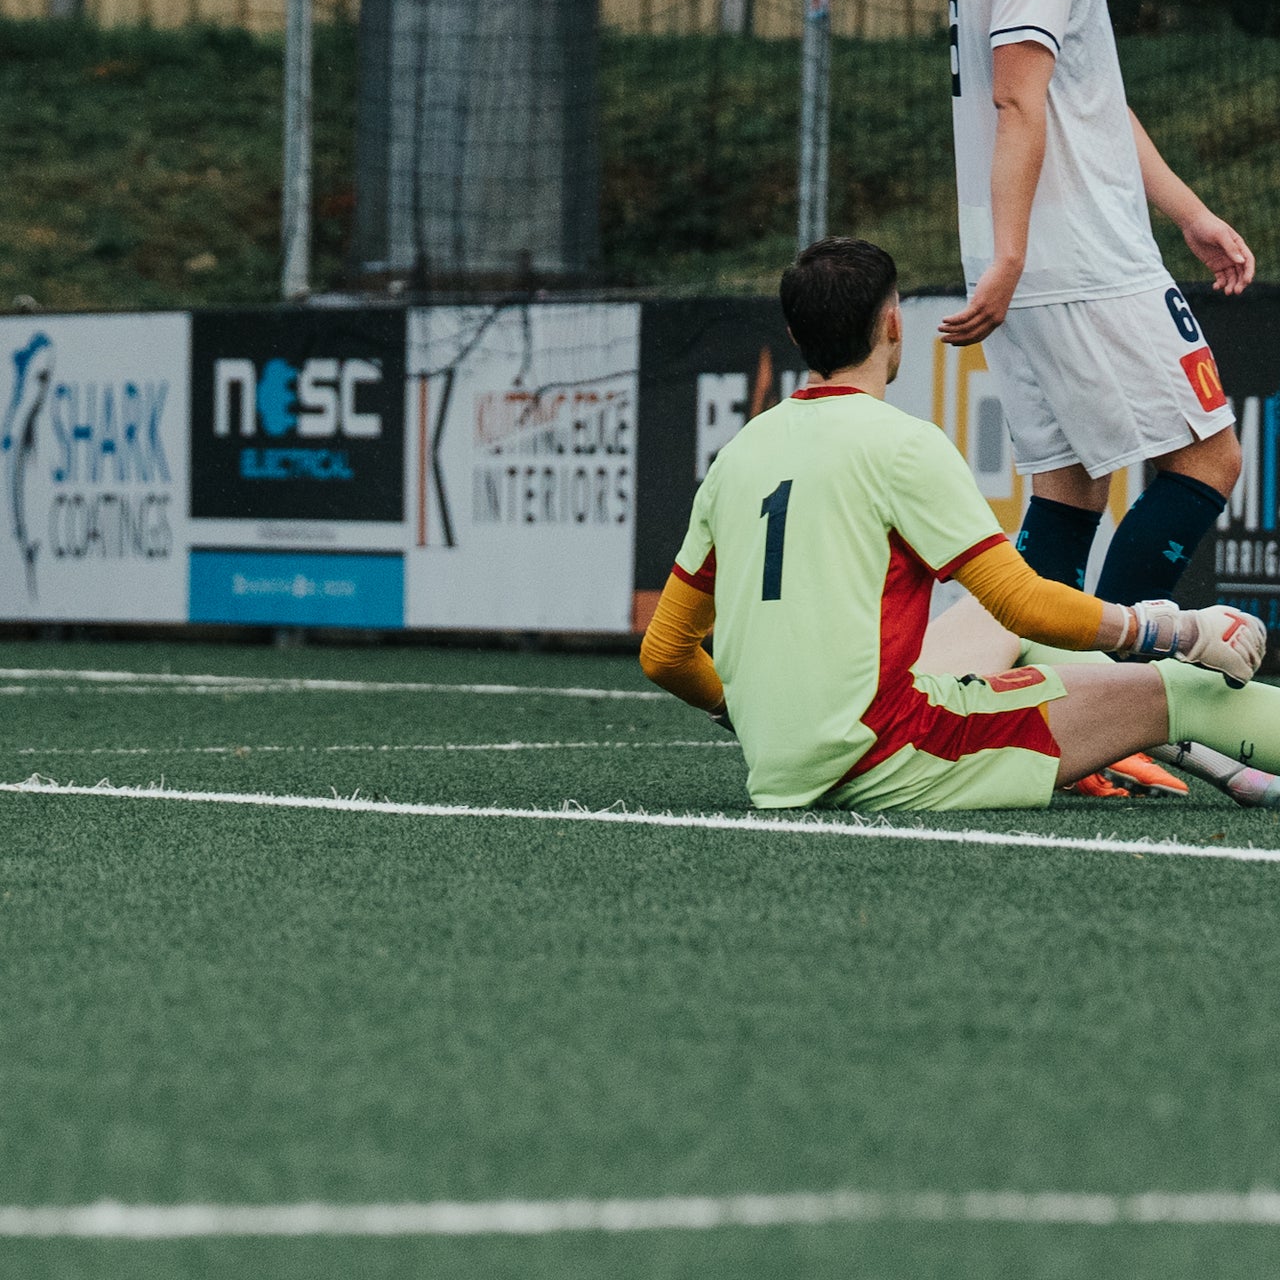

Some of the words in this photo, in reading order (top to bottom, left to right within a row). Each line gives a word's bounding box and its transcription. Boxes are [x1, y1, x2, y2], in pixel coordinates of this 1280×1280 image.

[1164, 287, 1200, 343] 6
[52, 381, 171, 484] SHARK
[50, 492, 172, 557] COATINGS
[471, 464, 629, 524] INTERIORS
[760, 479, 793, 602] 1
